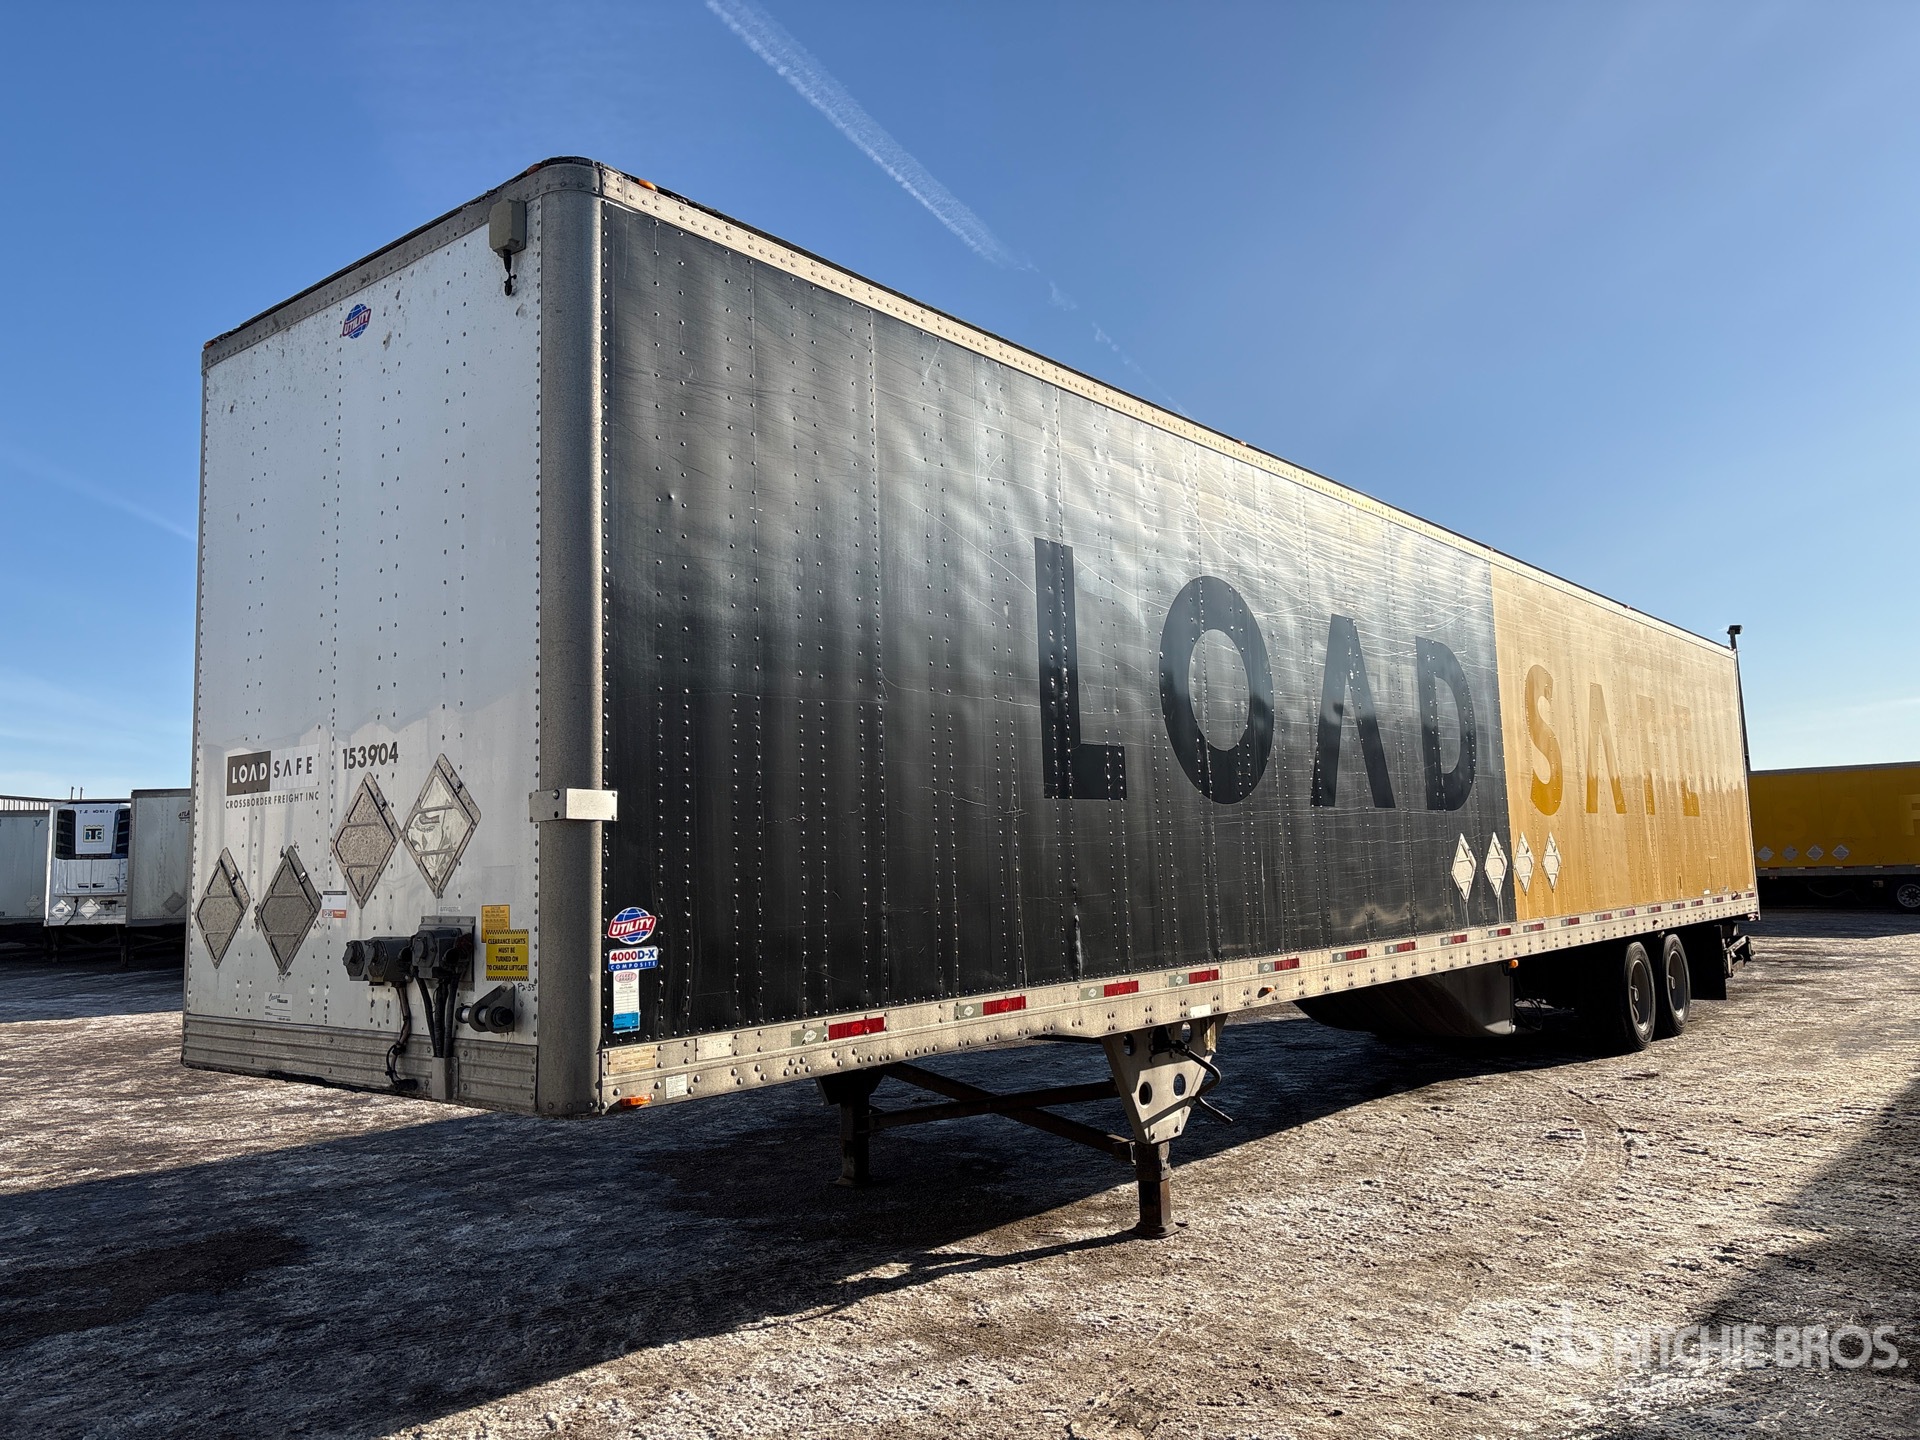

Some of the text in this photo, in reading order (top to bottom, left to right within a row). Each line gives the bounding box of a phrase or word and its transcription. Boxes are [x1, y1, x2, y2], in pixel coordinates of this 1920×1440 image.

[344, 310, 370, 335] UTILITY
[1033, 537, 1477, 812] LOAD
[343, 741, 399, 770] 153904
[231, 756, 313, 784] LOAD SAFE
[225, 791, 319, 810] CROSSBORDER FREIGHT INC
[611, 918, 653, 936] UTILITY
[610, 950, 656, 962] 4000D-X
[610, 961, 656, 970] COMPOSITE
